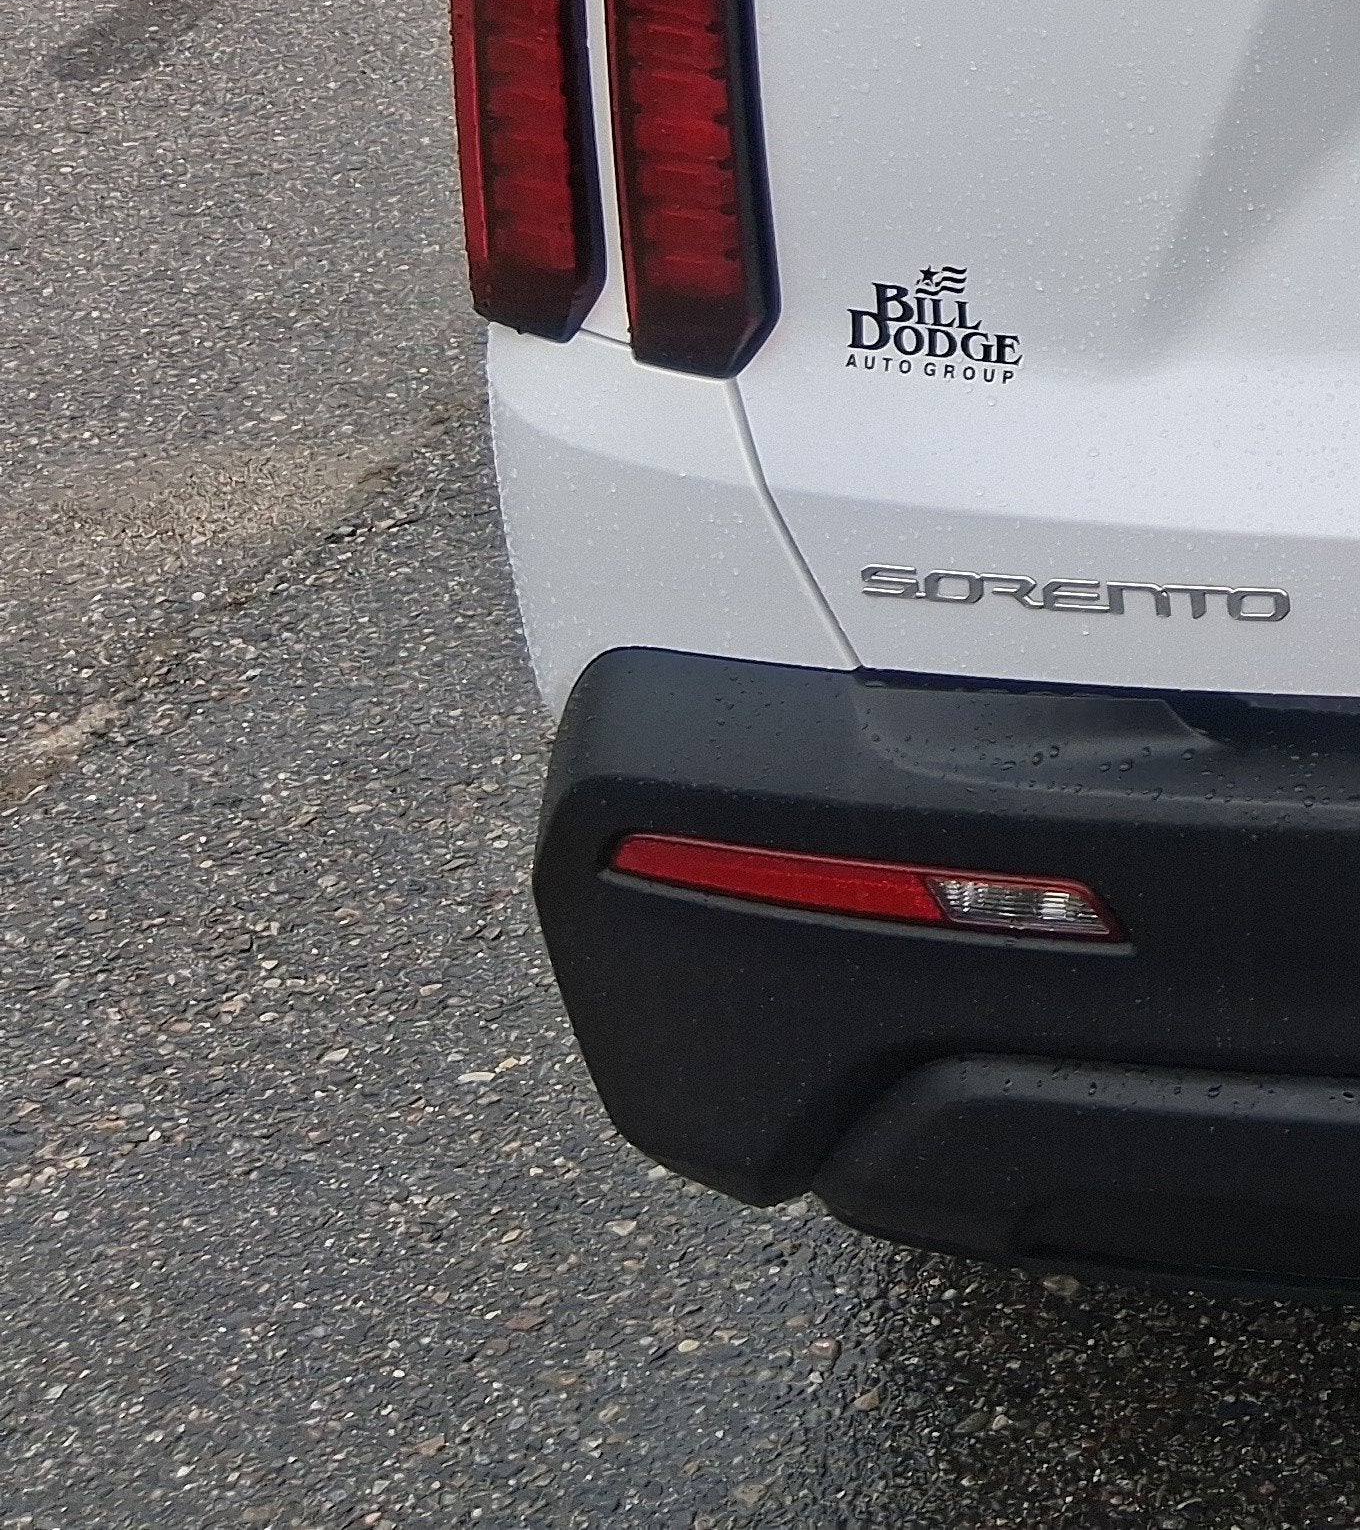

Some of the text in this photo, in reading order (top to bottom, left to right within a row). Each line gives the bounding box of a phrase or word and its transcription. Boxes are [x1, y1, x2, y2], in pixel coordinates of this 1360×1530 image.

[872, 282, 982, 330] BILL
[847, 308, 1022, 365] DODGE
[845, 354, 1014, 384] AUTO GROUP
[861, 563, 1291, 621] SORENTO
